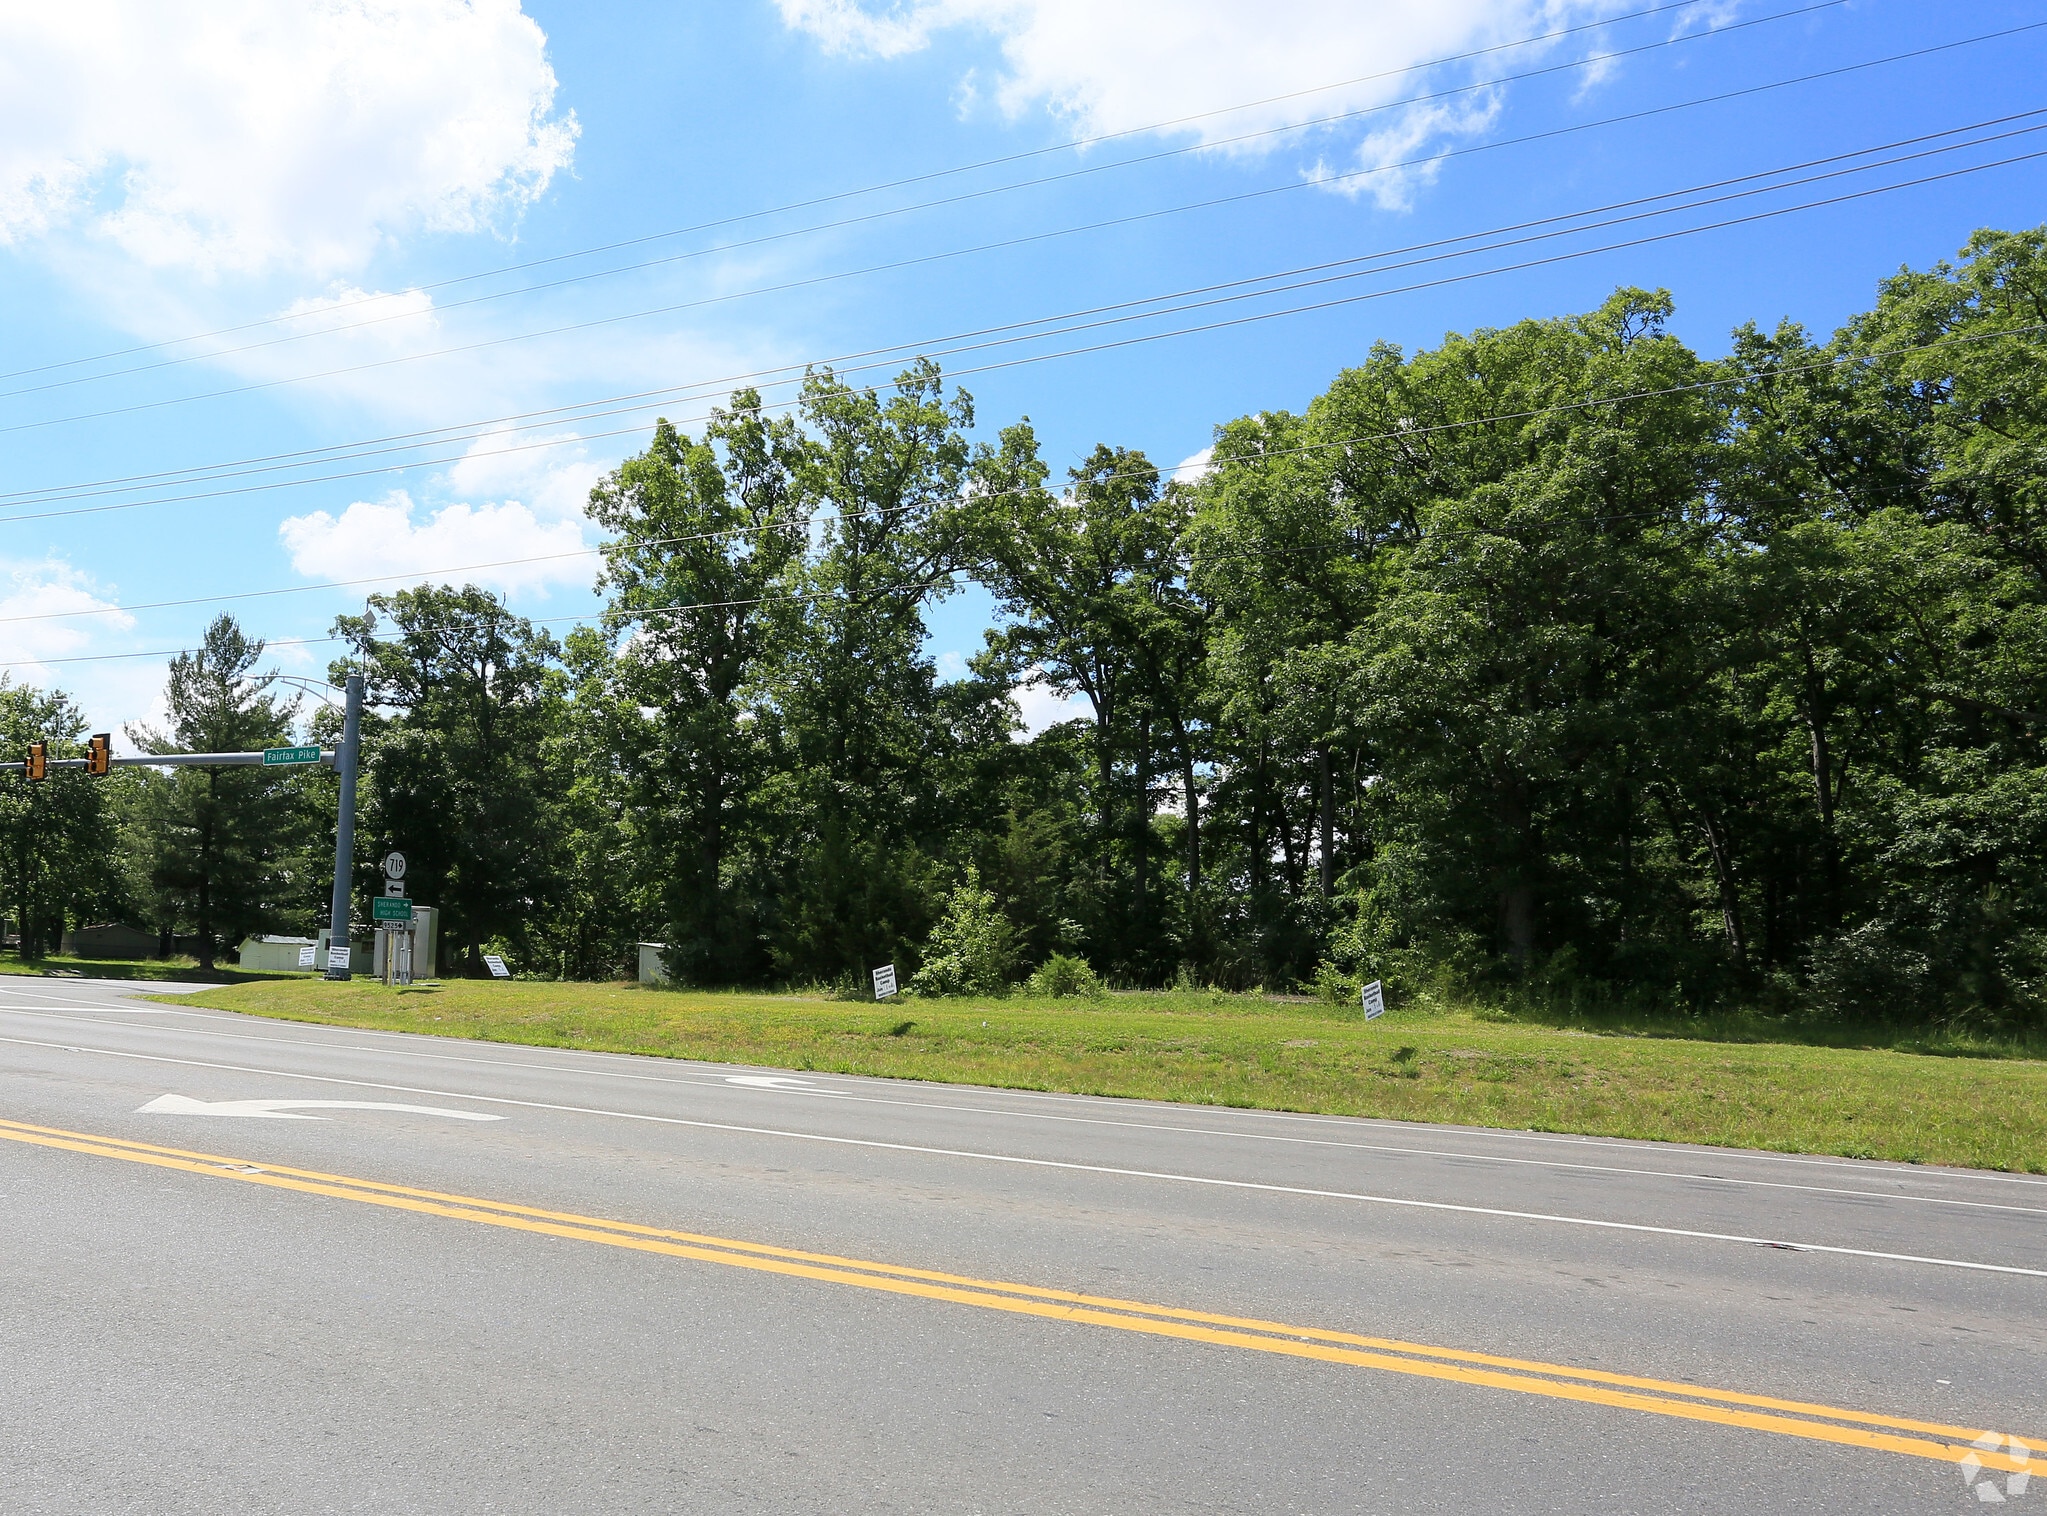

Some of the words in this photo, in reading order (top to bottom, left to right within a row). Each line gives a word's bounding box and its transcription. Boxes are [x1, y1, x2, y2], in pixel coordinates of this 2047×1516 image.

[267, 751, 295, 761] Fairfax
[298, 749, 316, 759] Pike
[390, 859, 403, 872] 719
